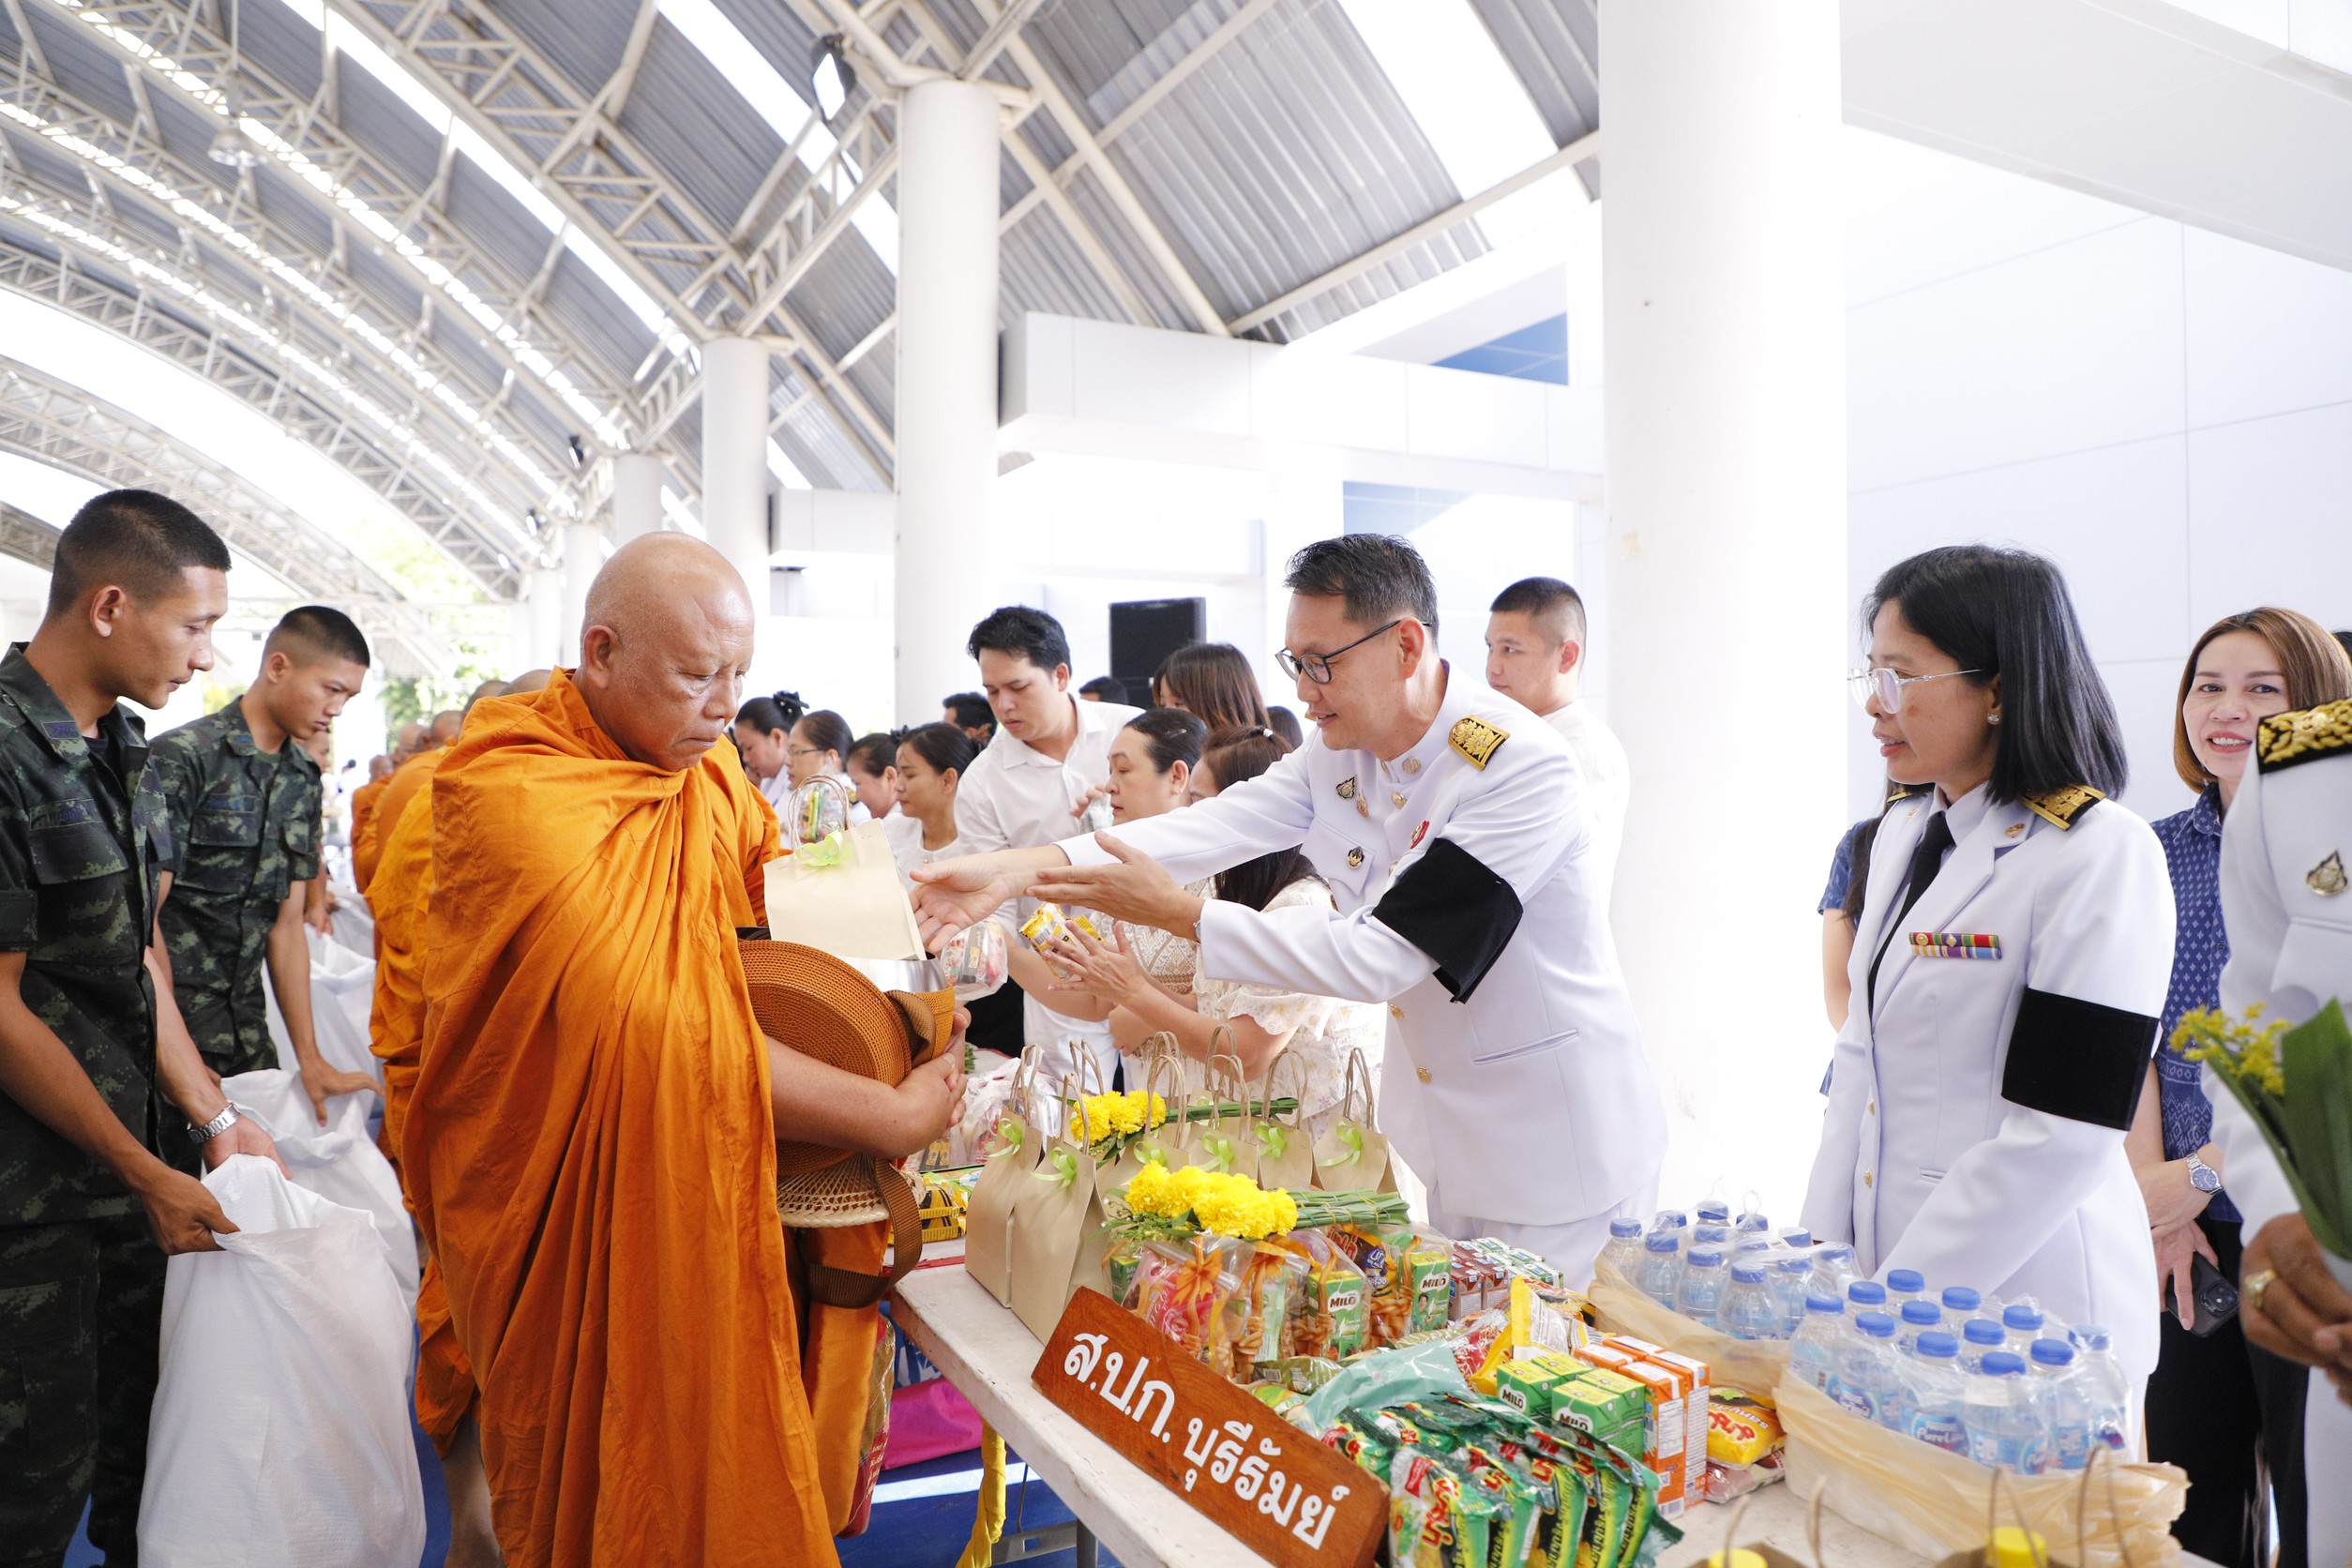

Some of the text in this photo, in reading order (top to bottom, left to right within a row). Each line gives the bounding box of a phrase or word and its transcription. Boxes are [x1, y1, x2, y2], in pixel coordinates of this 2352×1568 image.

[1330, 1296, 1356, 1308] MILO
[1501, 1389, 1524, 1409] MILO
[1064, 1333, 1175, 1443] ส.ป.ก.
[1184, 1418, 1350, 1550] บุรีรัมย์
